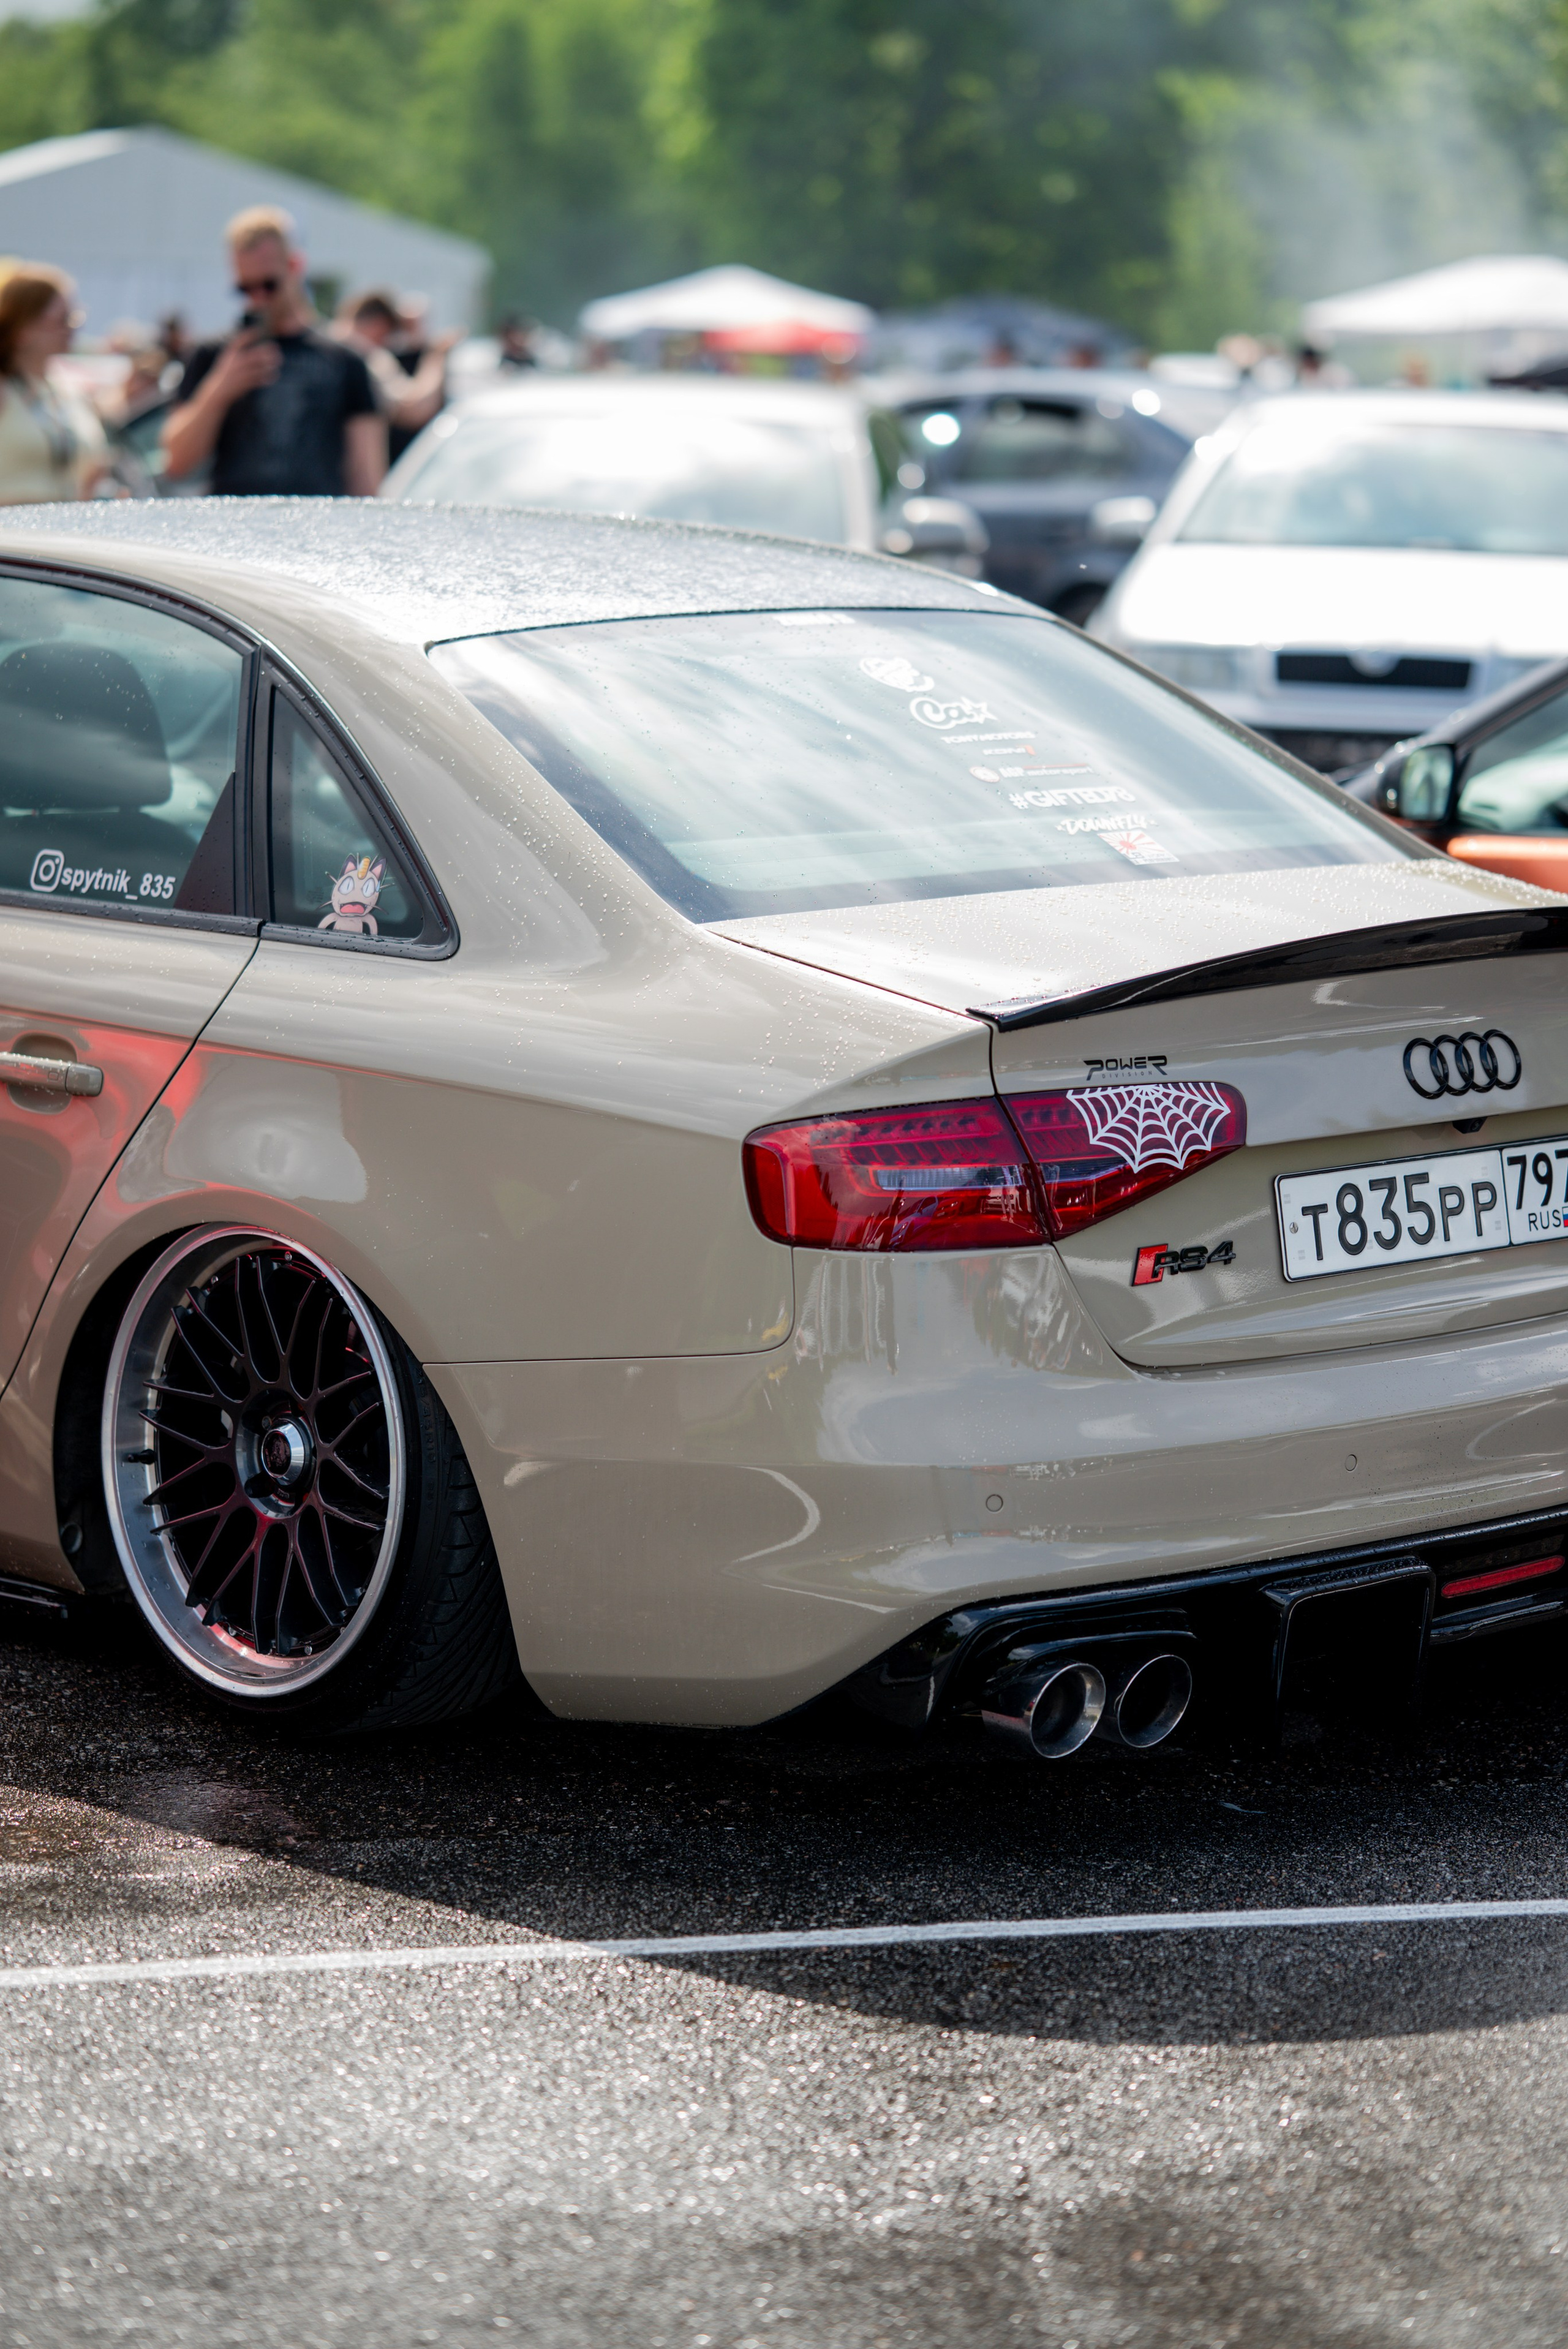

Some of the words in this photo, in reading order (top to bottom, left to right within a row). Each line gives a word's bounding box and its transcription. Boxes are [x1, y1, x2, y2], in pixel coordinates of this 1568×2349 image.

[1008, 785, 1136, 810] #GIFTED78
[62, 867, 176, 900] spytnik_835
[1083, 1055, 1168, 1081] POWER
[1301, 1172, 1497, 1261] T835PP
[1507, 1148, 1568, 1210] 797
[1528, 1209, 1561, 1232] RUS
[1150, 1240, 1237, 1278] RS4
